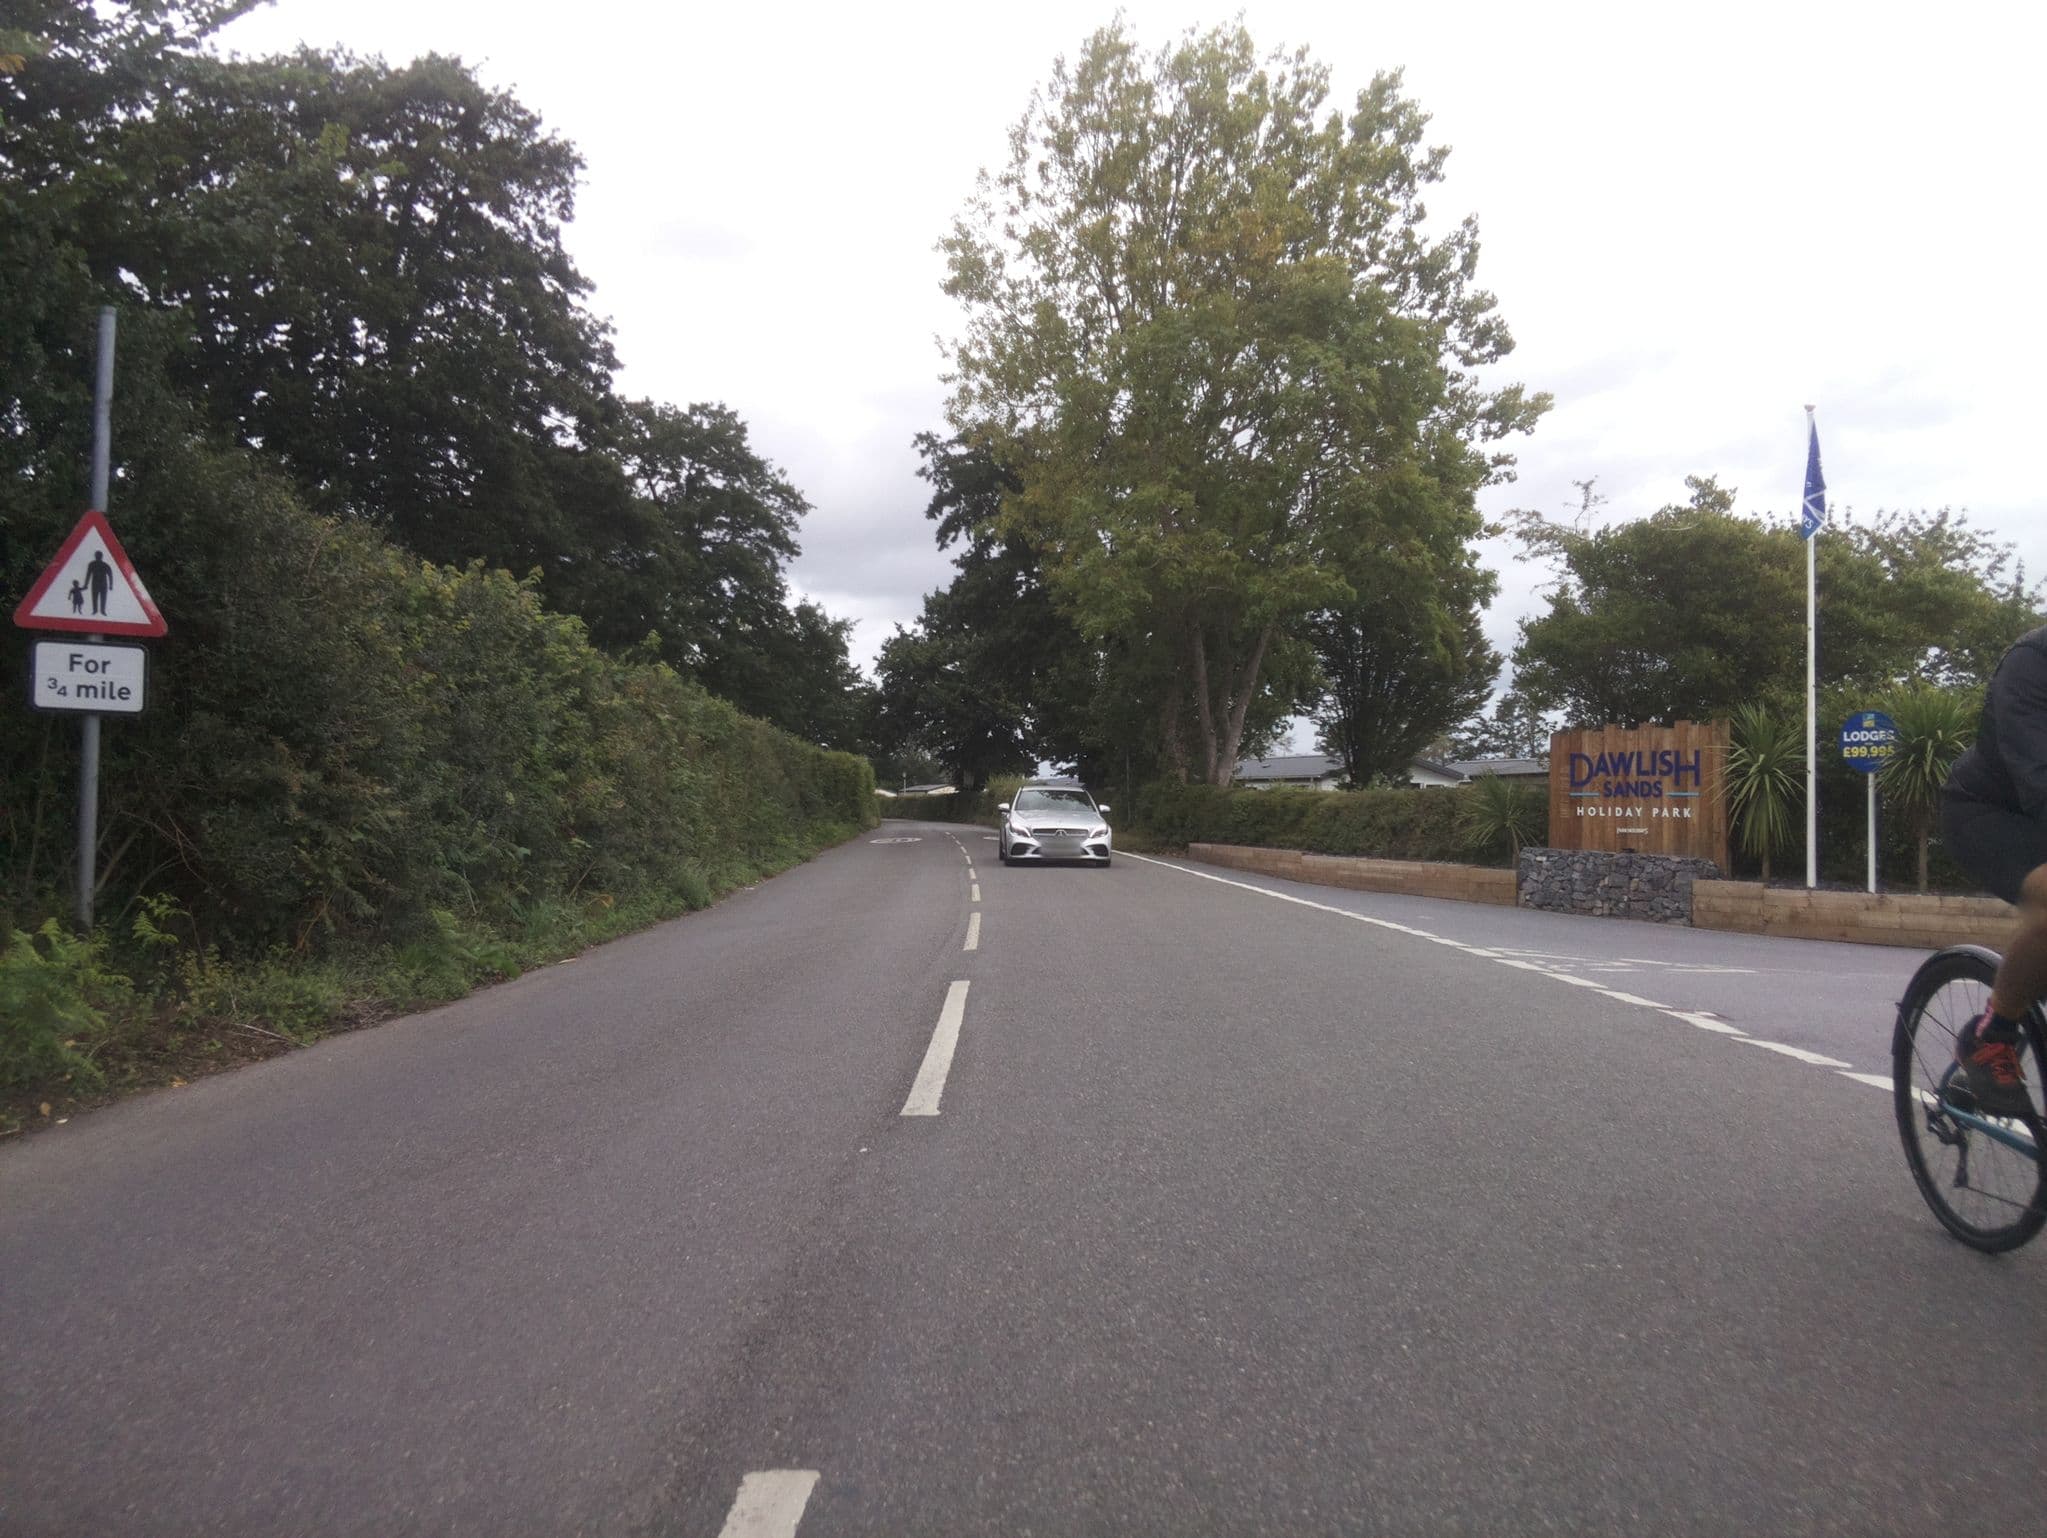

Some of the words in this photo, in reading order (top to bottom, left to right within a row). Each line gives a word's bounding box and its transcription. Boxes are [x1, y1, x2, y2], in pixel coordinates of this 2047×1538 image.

[69, 653, 111, 674] For
[76, 681, 131, 701] mile
[1569, 749, 1700, 787] DAWLISH
[1603, 780, 1663, 798] SANDS
[1576, 806, 1643, 817] HOLIDAY
[1652, 807, 1692, 818] PARK
